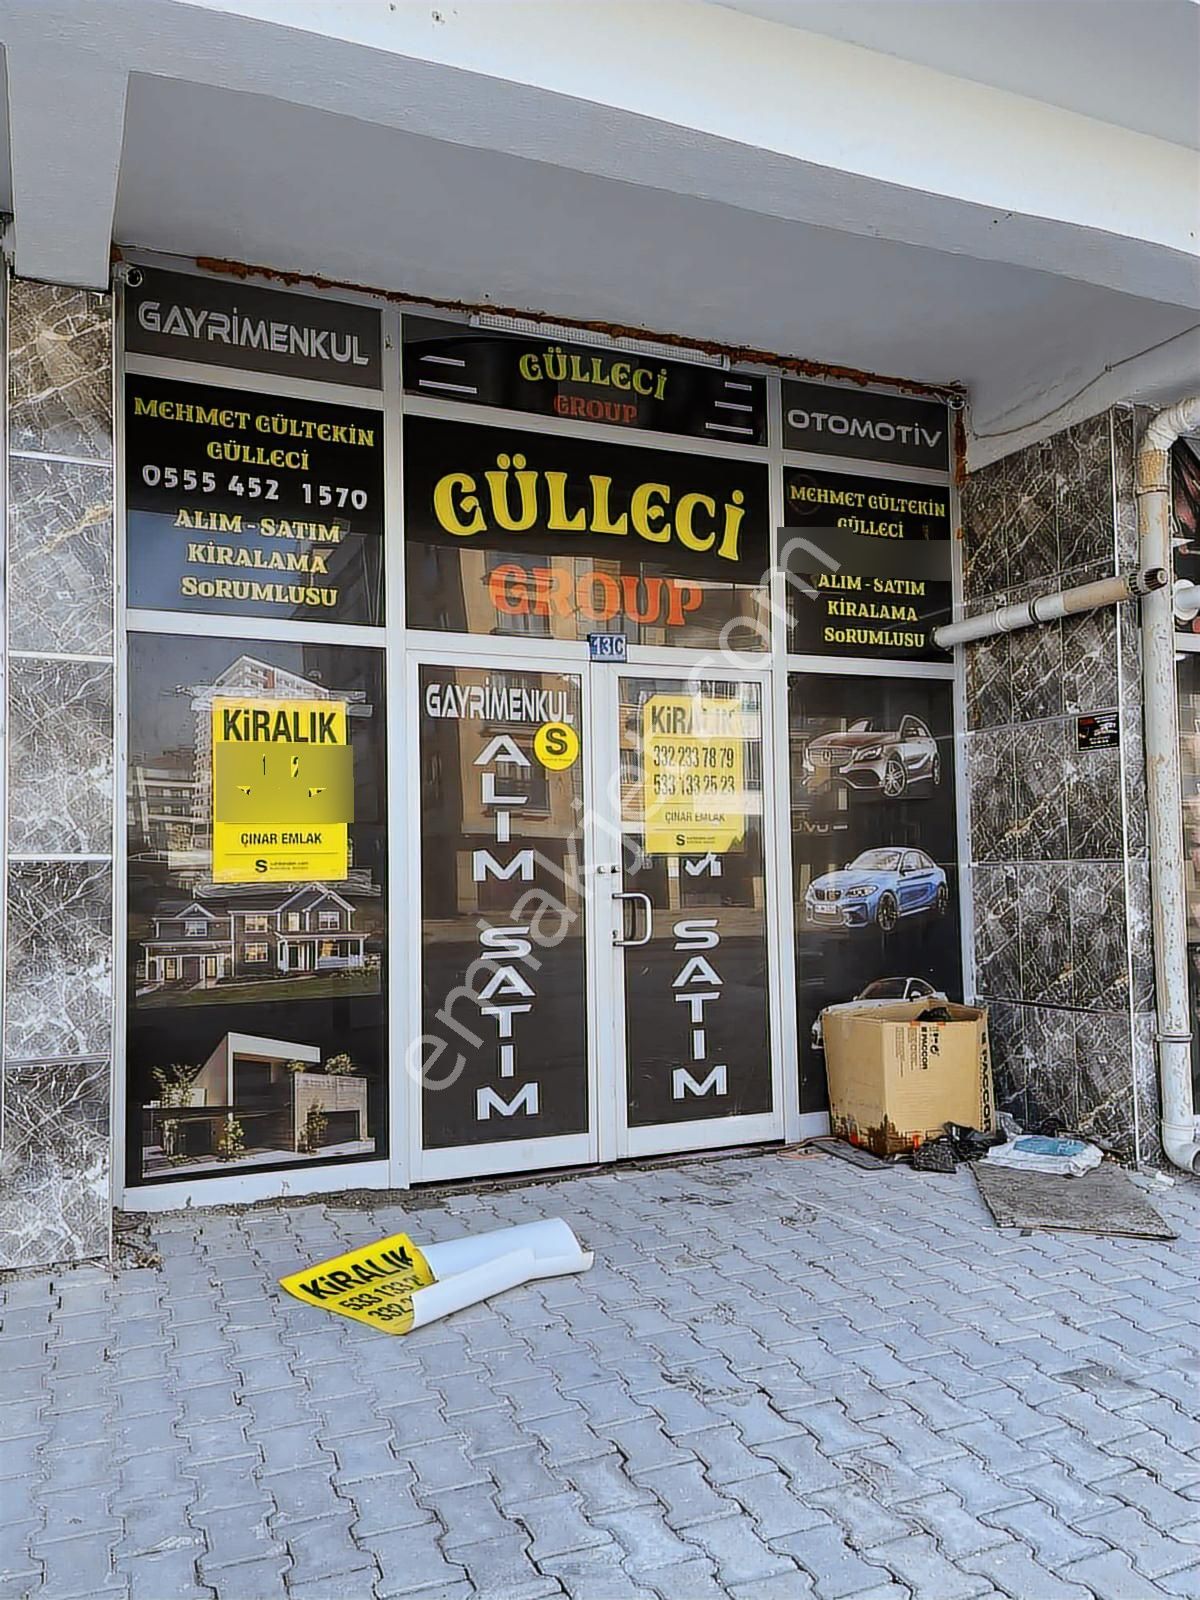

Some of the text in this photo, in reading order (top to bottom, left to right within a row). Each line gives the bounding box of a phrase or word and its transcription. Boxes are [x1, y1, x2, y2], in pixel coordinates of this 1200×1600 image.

[138, 300, 369, 366] GAYRİMENKUL
[519, 347, 668, 400] GÜLLECİ
[134, 397, 375, 447] MEHMET GÜLTEKİN
[554, 394, 638, 423] GROUP
[787, 409, 943, 448] OTOMOTİV
[207, 440, 310, 471] GÜLLECİ
[142, 465, 368, 510] 0555 452 1570
[790, 485, 946, 518] MEHMET GÜLTEKİN
[433, 453, 745, 561] GÜLLECİ
[173, 508, 243, 534] ALIM
[260, 517, 341, 544] SATIM
[187, 541, 329, 574] KİRALAMA
[488, 564, 703, 627] GROUP
[817, 574, 862, 592] ALIM
[873, 578, 926, 596] SATIM
[827, 598, 918, 622] KİRALAMA
[426, 677, 574, 724] GAYRİMENKUL
[653, 745, 734, 769] 332 233 78 79
[653, 774, 735, 796] 533 133 25 23
[474, 734, 535, 882] ALIM
[240, 833, 322, 848] ÇINAR EMLAK
[477, 925, 541, 1122] SATIM
[671, 918, 728, 1101] SATIM
[338, 1293, 383, 1311] 533
